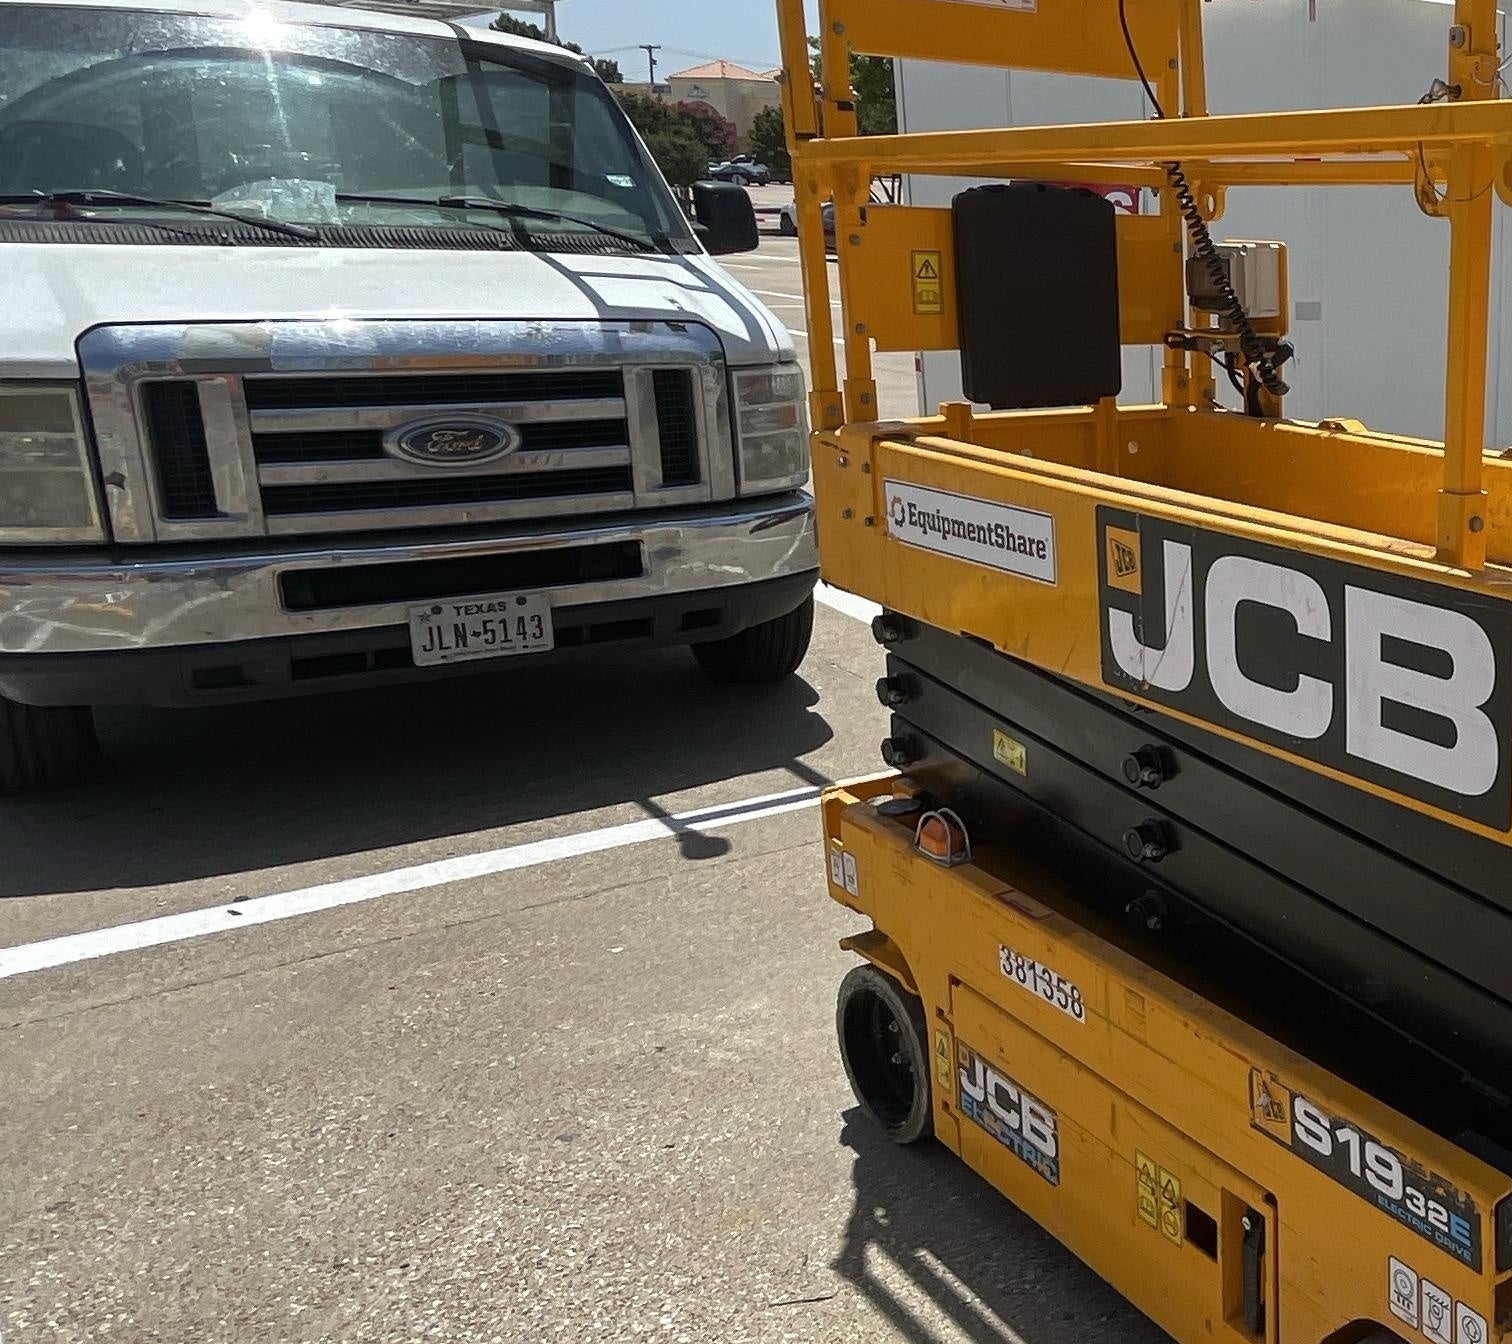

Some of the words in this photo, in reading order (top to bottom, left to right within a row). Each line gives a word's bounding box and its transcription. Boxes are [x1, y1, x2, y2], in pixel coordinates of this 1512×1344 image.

[906, 501, 1048, 561] EquipmentShare
[453, 601, 507, 617] TEXAS
[1107, 538, 1500, 797] JCB
[1000, 943, 1085, 1020] 381358
[959, 1055, 1057, 1158] JCB
[1377, 1193, 1432, 1237] ELECTRIC
[1434, 1229, 1473, 1262] DRIVE
